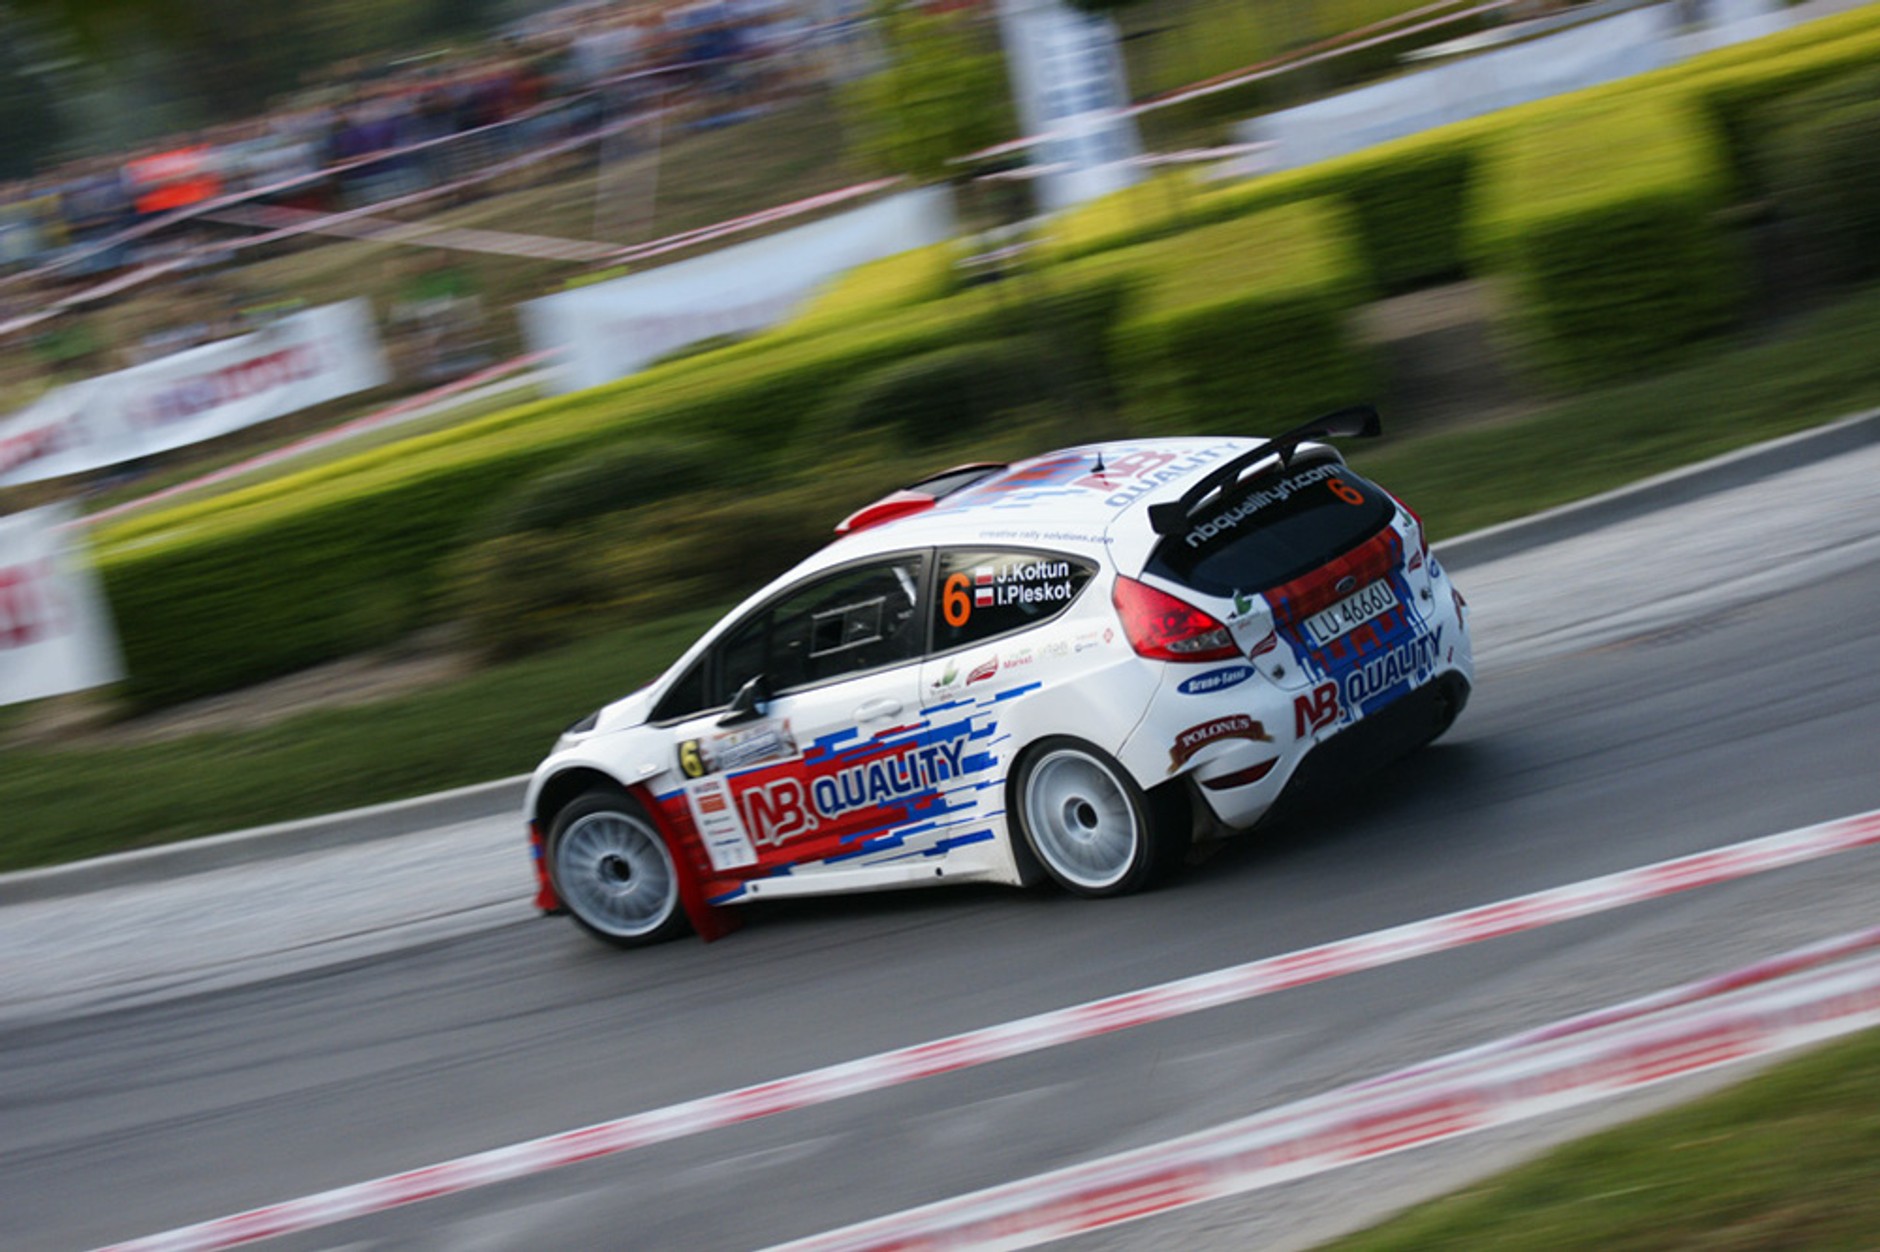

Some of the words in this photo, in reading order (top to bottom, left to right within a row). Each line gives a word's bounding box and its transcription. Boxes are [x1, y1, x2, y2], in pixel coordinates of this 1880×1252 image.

[1105, 441, 1240, 508] QUALITY
[1327, 478, 1365, 506] 6
[997, 562, 1069, 584] J.Kołtun
[997, 581, 1072, 606] I.Pleskot
[943, 572, 972, 627] 6
[1308, 611, 1340, 643] LU
[1342, 581, 1394, 624] 4666U
[1347, 624, 1442, 704] QUALITY
[1182, 718, 1250, 747] POLONUS
[680, 740, 704, 777] 6
[812, 734, 970, 819] QUALITY
